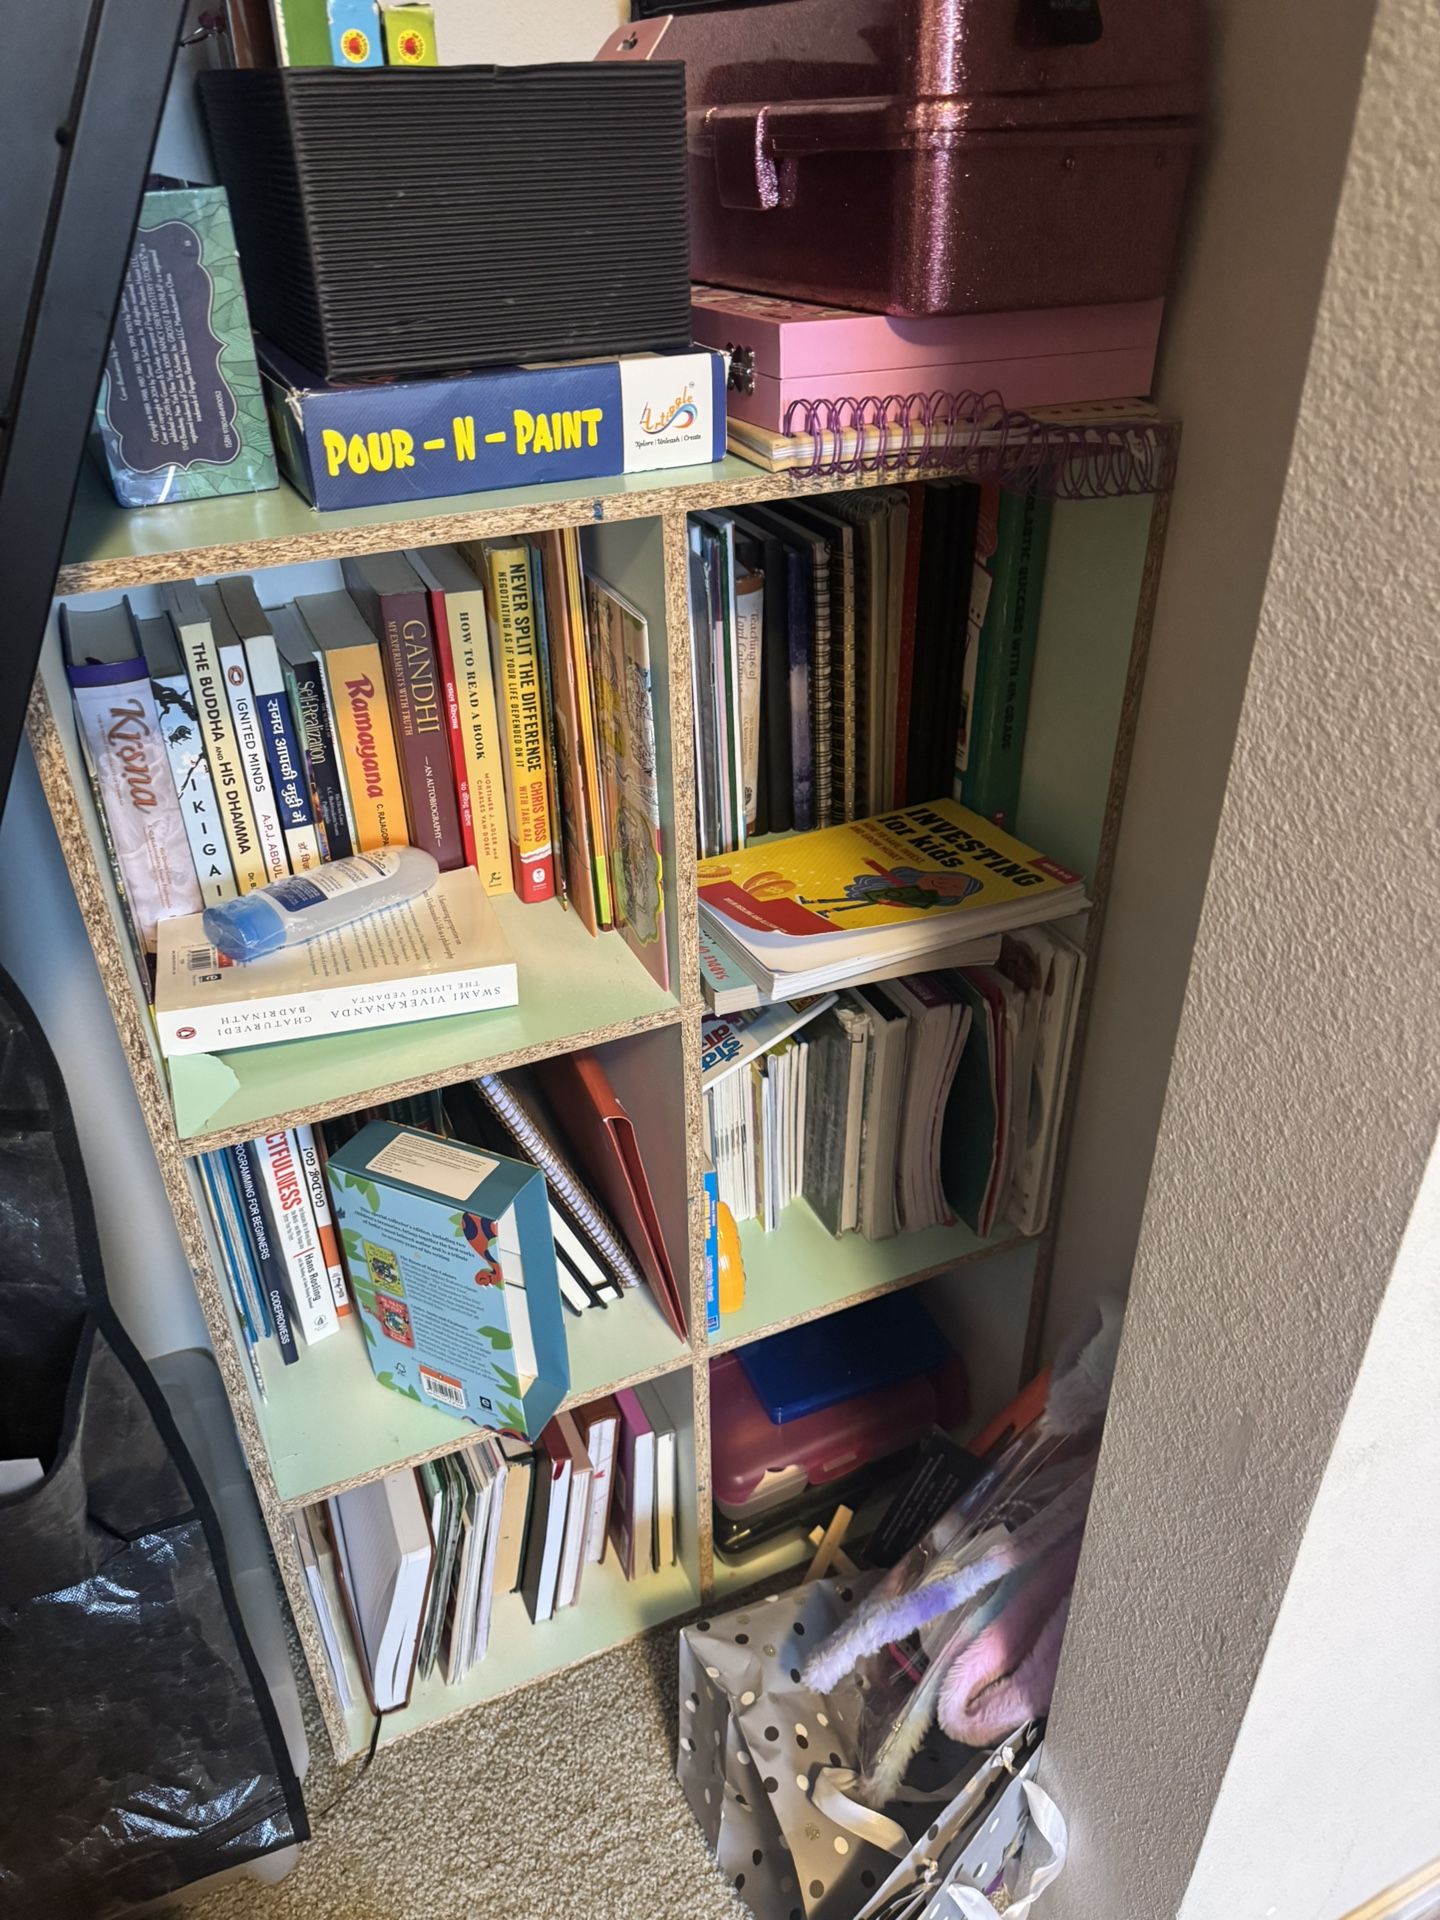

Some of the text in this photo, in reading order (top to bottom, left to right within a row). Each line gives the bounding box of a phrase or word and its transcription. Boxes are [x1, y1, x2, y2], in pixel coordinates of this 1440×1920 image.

[322, 429, 416, 477] POUR
[453, 416, 477, 462] N
[513, 408, 603, 456] PAINT
[509, 563, 542, 772] NEVER SPLIT THE DIFFERENCE
[747, 612, 759, 667] Teachings
[386, 621, 412, 735] MY EXPERIMENTS WITH TRUTH
[400, 619, 440, 734] GANDHI
[458, 612, 484, 760] HOW TO READ A BOOK
[497, 571, 524, 768] NEGOTIATING AS IF YOUR LIFE DEPENDED ON IT
[235, 698, 266, 792] IGNITED MINDS
[265, 699, 284, 734] समय
[295, 680, 327, 764] Self-Realization
[343, 672, 385, 799] Ramayana
[190, 642, 251, 856] THE BUDDHA AND HIS DHAMMA
[274, 737, 298, 781] आपकी
[289, 808, 306, 825] में
[425, 778, 441, 839] AUTOBIOGRAPHY
[475, 779, 485, 813] CHARLES
[482, 831, 490, 856] DOREN
[483, 772, 493, 811] MORTIMER
[518, 785, 528, 805] WITH
[529, 780, 546, 843] CHRIS VOSS
[261, 813, 284, 879] A.P.J. ABDUL
[377, 811, 390, 847] RAJAGOPA
[877, 815, 917, 837] for
[908, 833, 964, 868] kids
[905, 808, 1044, 887] INVESTING
[219, 1005, 305, 1025] BADRINATH
[329, 985, 500, 1019] SWAMI VIVEKANANDA
[351, 979, 479, 1004] THE LIVING VEDANTA
[216, 1014, 311, 1036] CHATURVEDI
[265, 1133, 303, 1211] CTFULNESS
[301, 1146, 316, 1165] Go!
[307, 1167, 322, 1190] Dog.
[233, 1141, 270, 1260] ROGRAMMING FOR BEGINNERS
[303, 1252, 316, 1273] Hans
[308, 1272, 323, 1301] Rosling
[269, 1289, 290, 1345] CODEPROWESS
